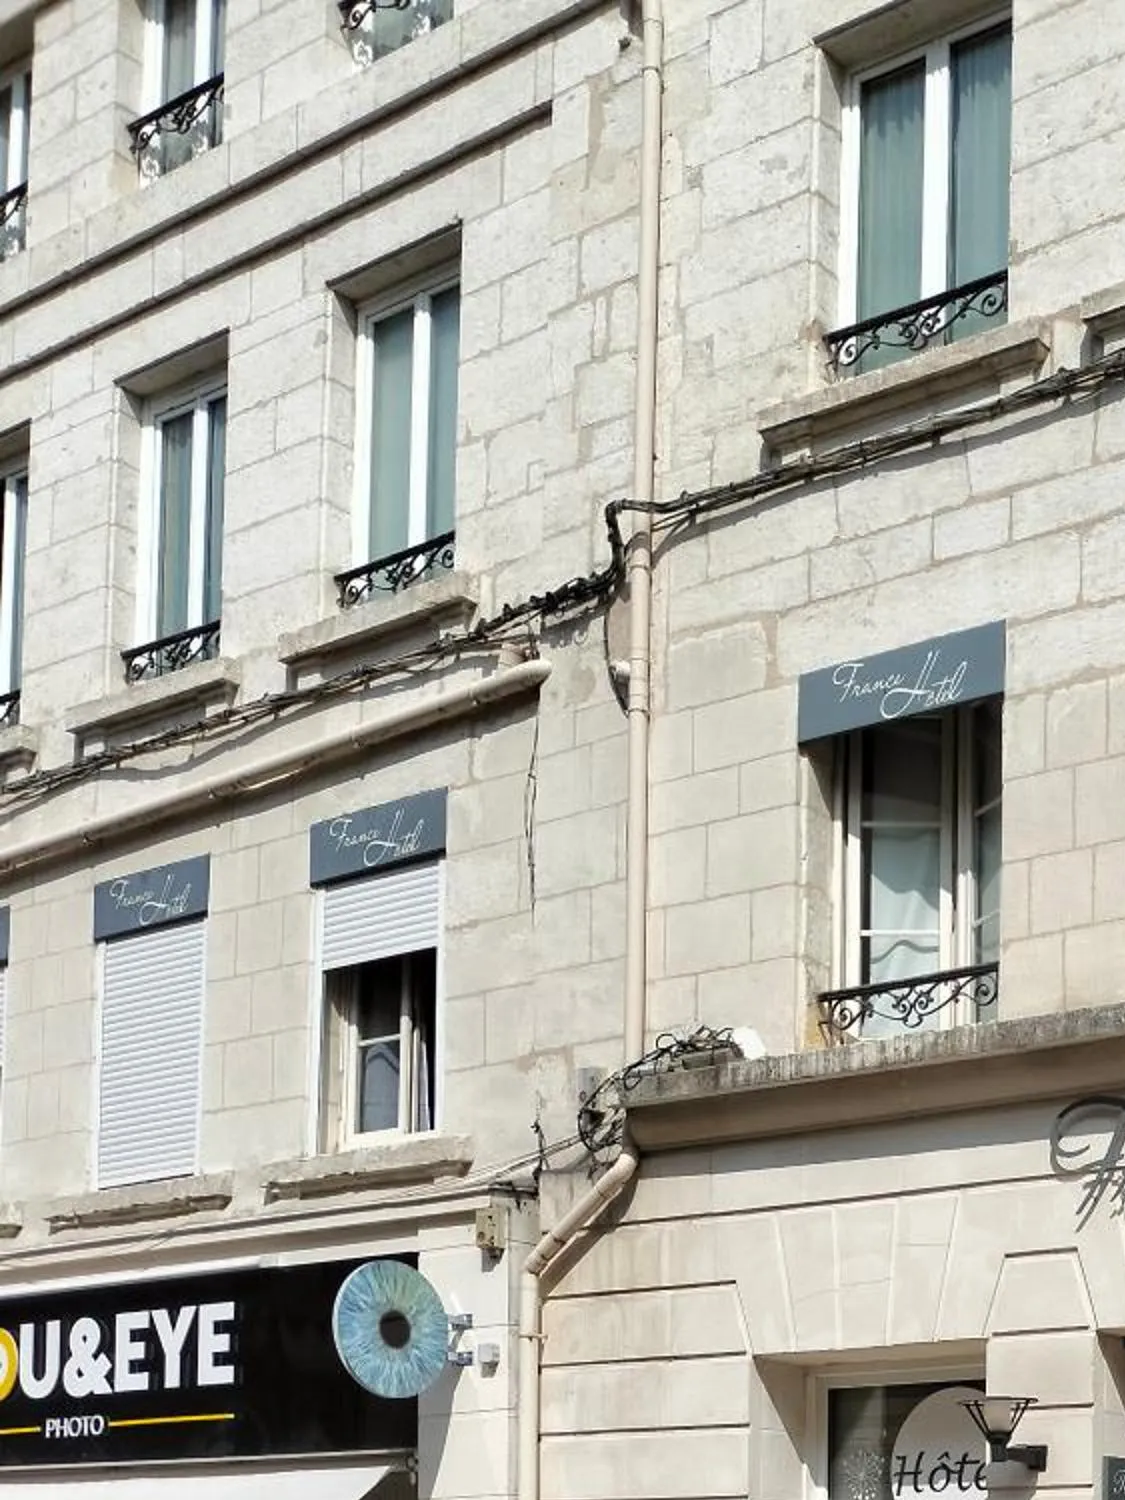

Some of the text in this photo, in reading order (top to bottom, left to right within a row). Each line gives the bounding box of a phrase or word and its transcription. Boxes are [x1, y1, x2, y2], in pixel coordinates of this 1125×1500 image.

[832, 663, 911, 702] France
[329, 818, 381, 852] France
[44, 1415, 105, 1439] PHOTO
